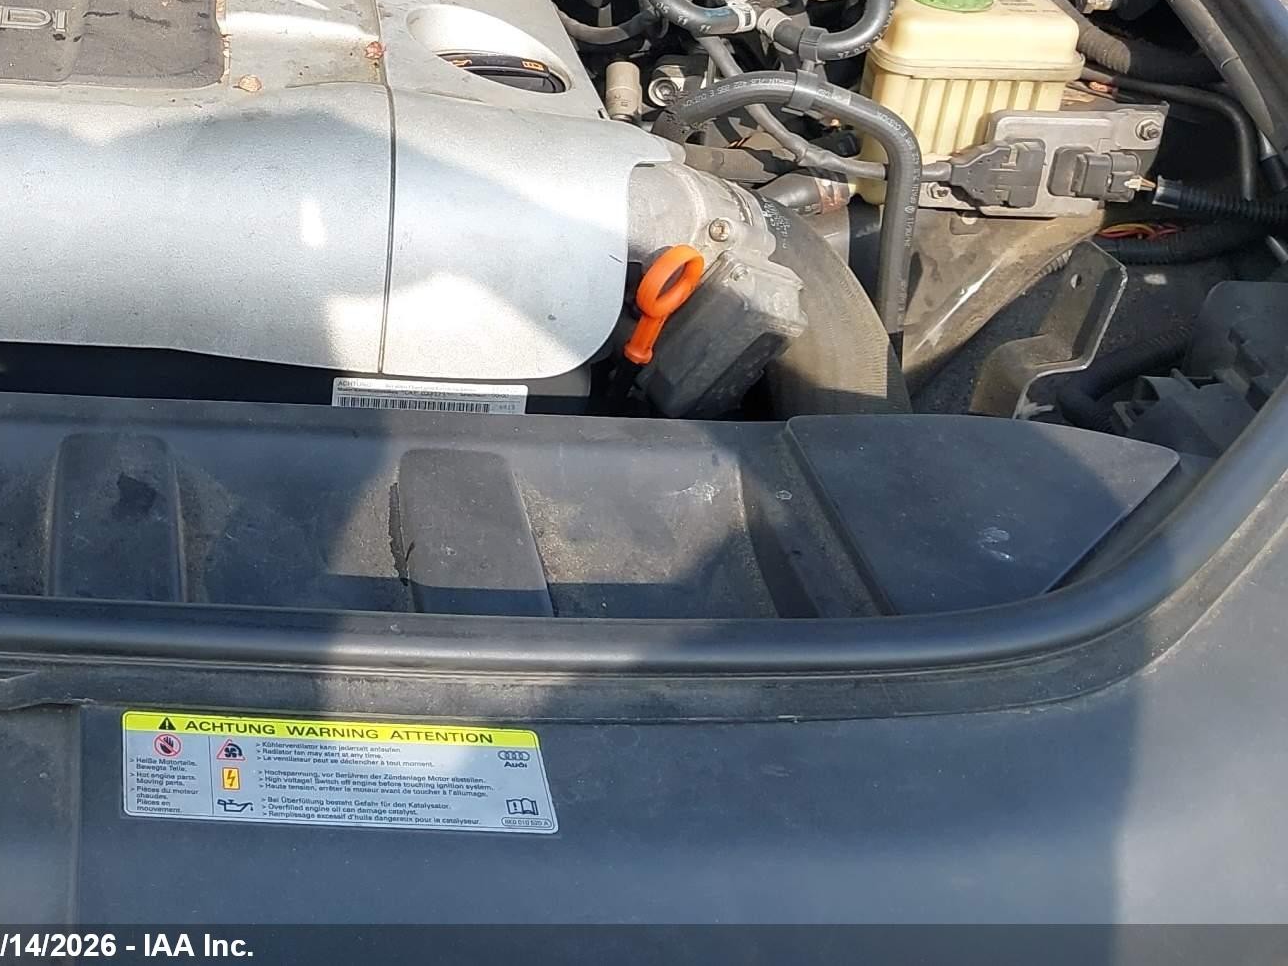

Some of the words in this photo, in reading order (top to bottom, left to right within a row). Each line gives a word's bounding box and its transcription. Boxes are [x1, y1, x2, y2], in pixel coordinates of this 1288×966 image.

[184, 720, 276, 735] ACHTUNG
[286, 725, 379, 739] WARNING
[390, 730, 493, 744] ATTENTION
[136, 778, 164, 786] Moving
[268, 811, 315, 819] Remplissage
[357, 807, 387, 815] damage
